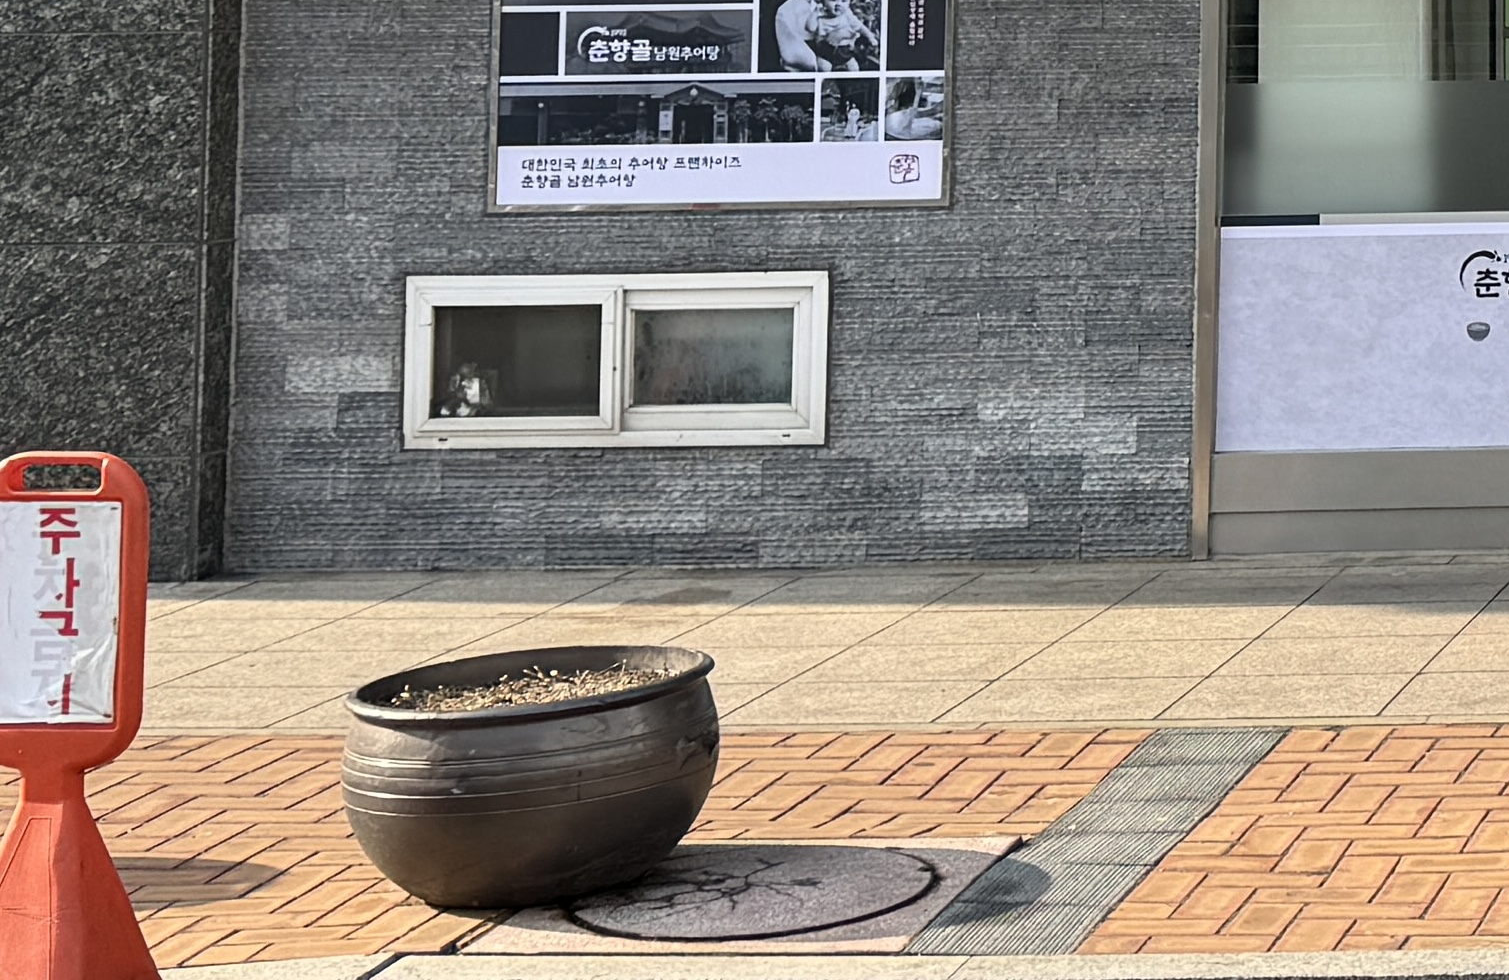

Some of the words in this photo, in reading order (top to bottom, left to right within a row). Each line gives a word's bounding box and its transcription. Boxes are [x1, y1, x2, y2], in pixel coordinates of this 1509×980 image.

[588, 39, 652, 62] 춘향골
[654, 45, 719, 61] 남원추어탕
[522, 158, 576, 171] 대한민국
[582, 157, 622, 170] 최초의
[628, 157, 668, 170] 추어탕
[521, 175, 561, 188] 춘향골
[567, 174, 635, 188] 남원추어탕
